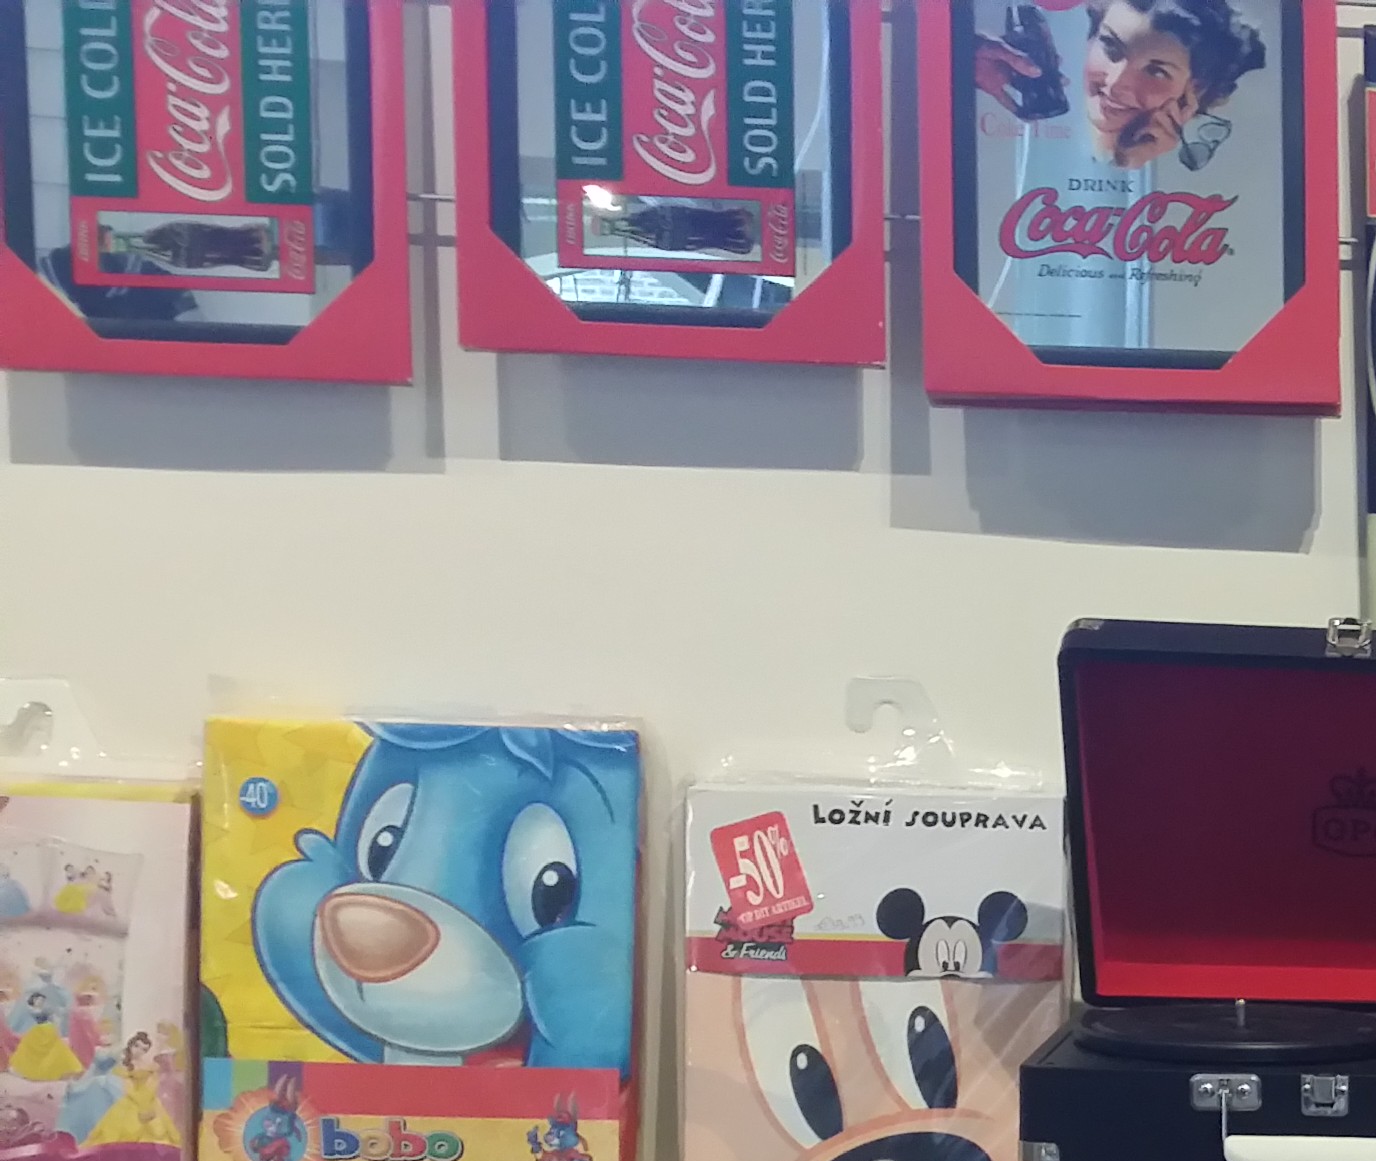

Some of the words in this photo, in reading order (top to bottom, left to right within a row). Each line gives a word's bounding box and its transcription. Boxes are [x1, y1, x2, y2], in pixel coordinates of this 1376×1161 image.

[257, 0, 293, 82] HER
[83, 115, 123, 182] ICE
[259, 95, 297, 193] SOLD
[570, 99, 608, 165] ICE
[743, 80, 777, 177] SOLD
[1068, 178, 1135, 193] DRINK
[998, 187, 1239, 265] Coca-Cola
[1038, 264, 1104, 279] Delicious
[1128, 267, 1202, 286] Refreshing
[905, 810, 1047, 831] SOUPRAVA
[729, 824, 789, 906] -50%
[721, 944, 738, 958] &
[740, 943, 787, 960] Friends
